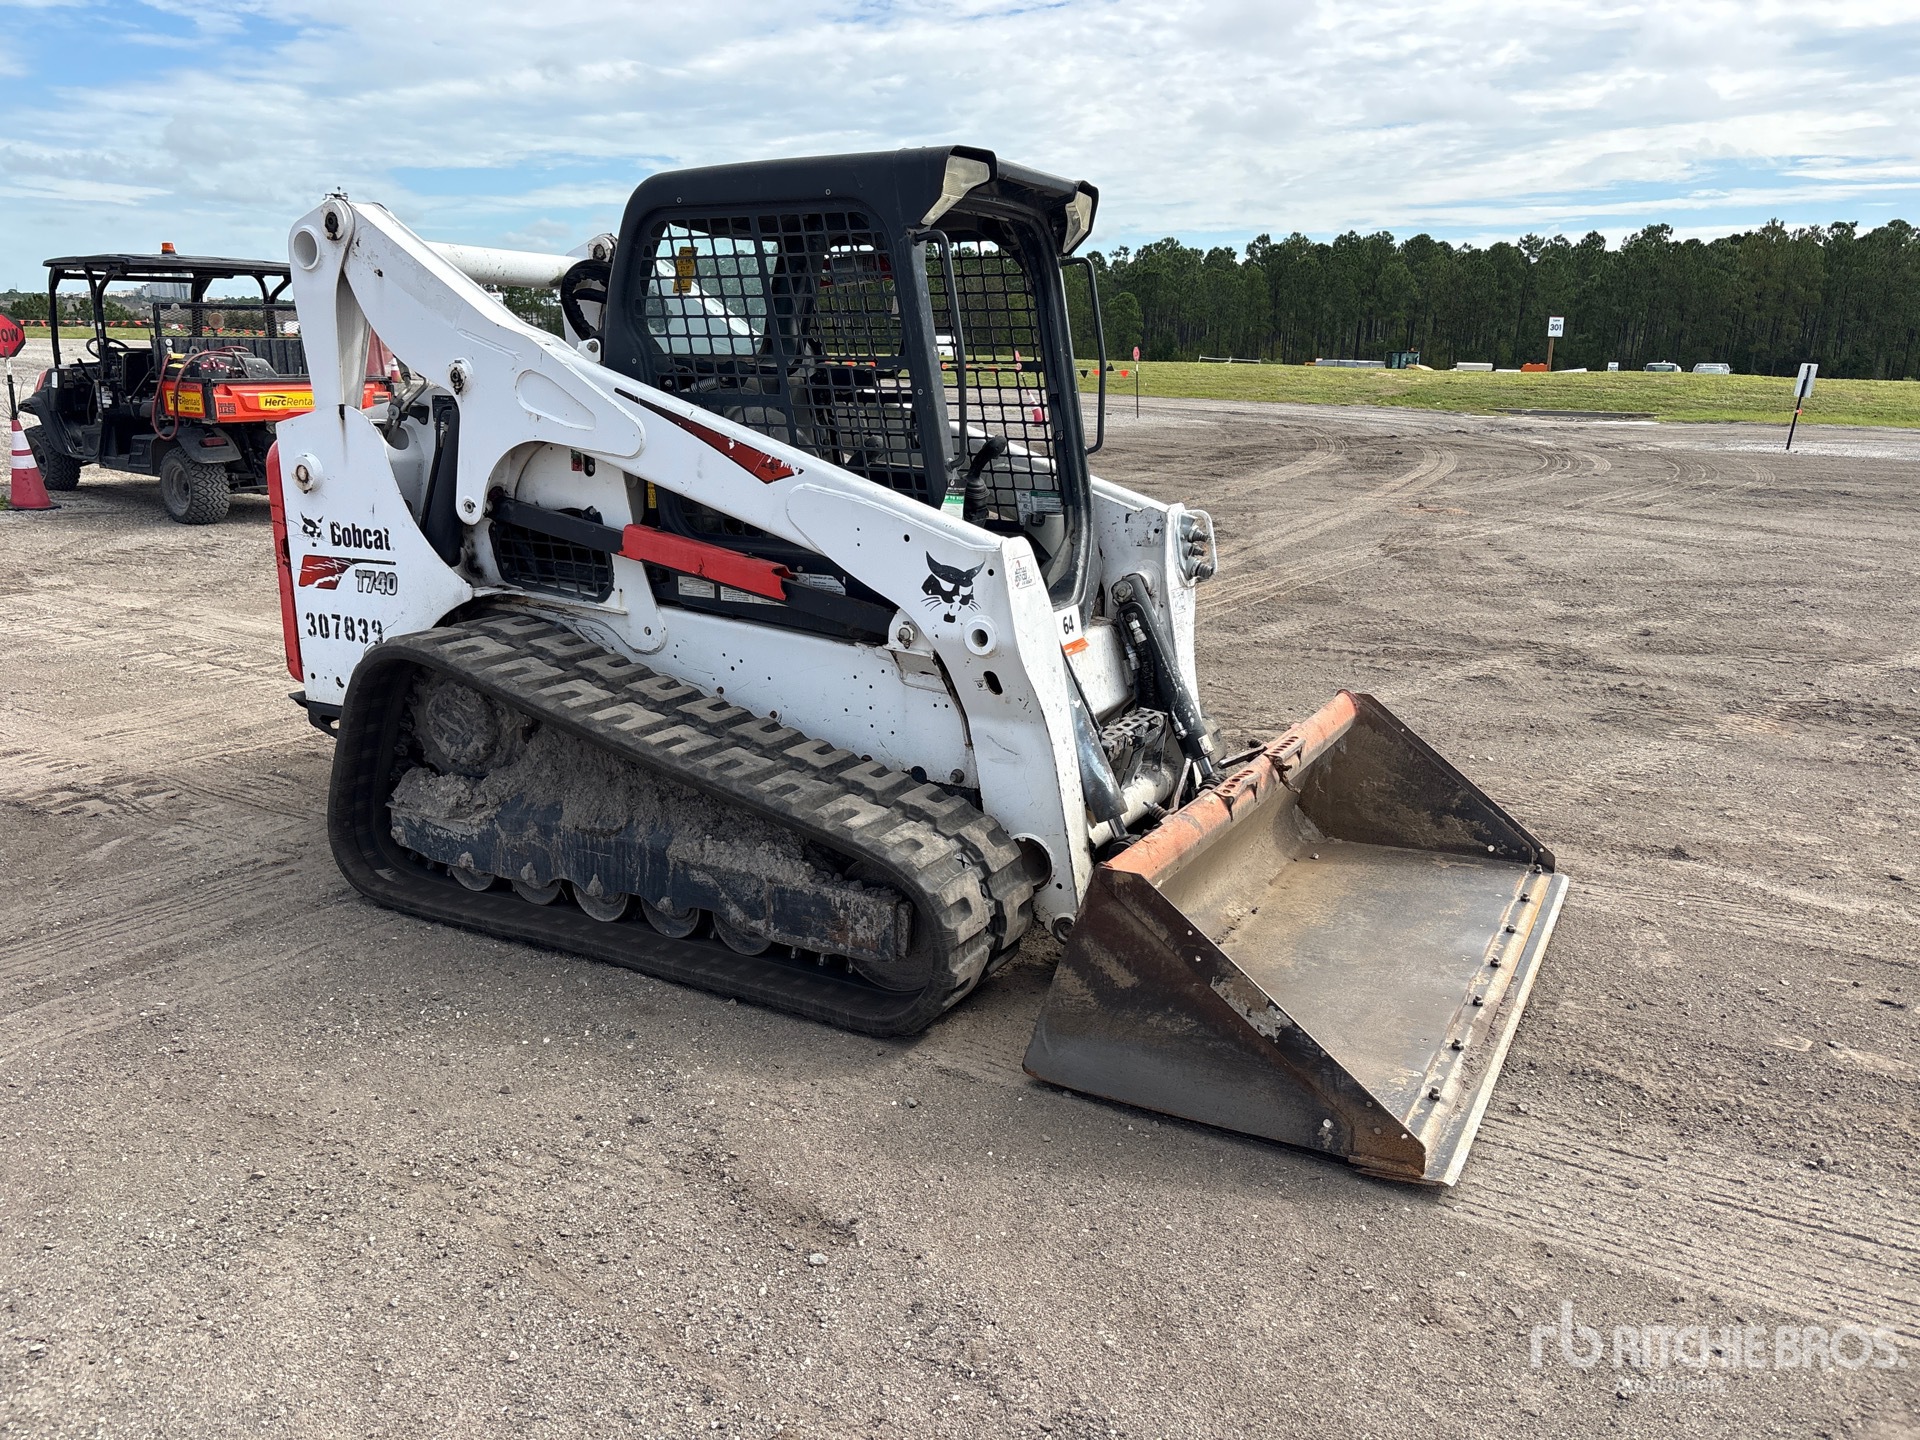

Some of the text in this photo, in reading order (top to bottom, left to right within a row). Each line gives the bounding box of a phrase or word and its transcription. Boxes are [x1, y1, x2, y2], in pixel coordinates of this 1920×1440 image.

[0, 328, 18, 342] OW
[330, 521, 390, 551] Bobcat
[355, 569, 398, 596] T740
[1063, 614, 1074, 635] 64
